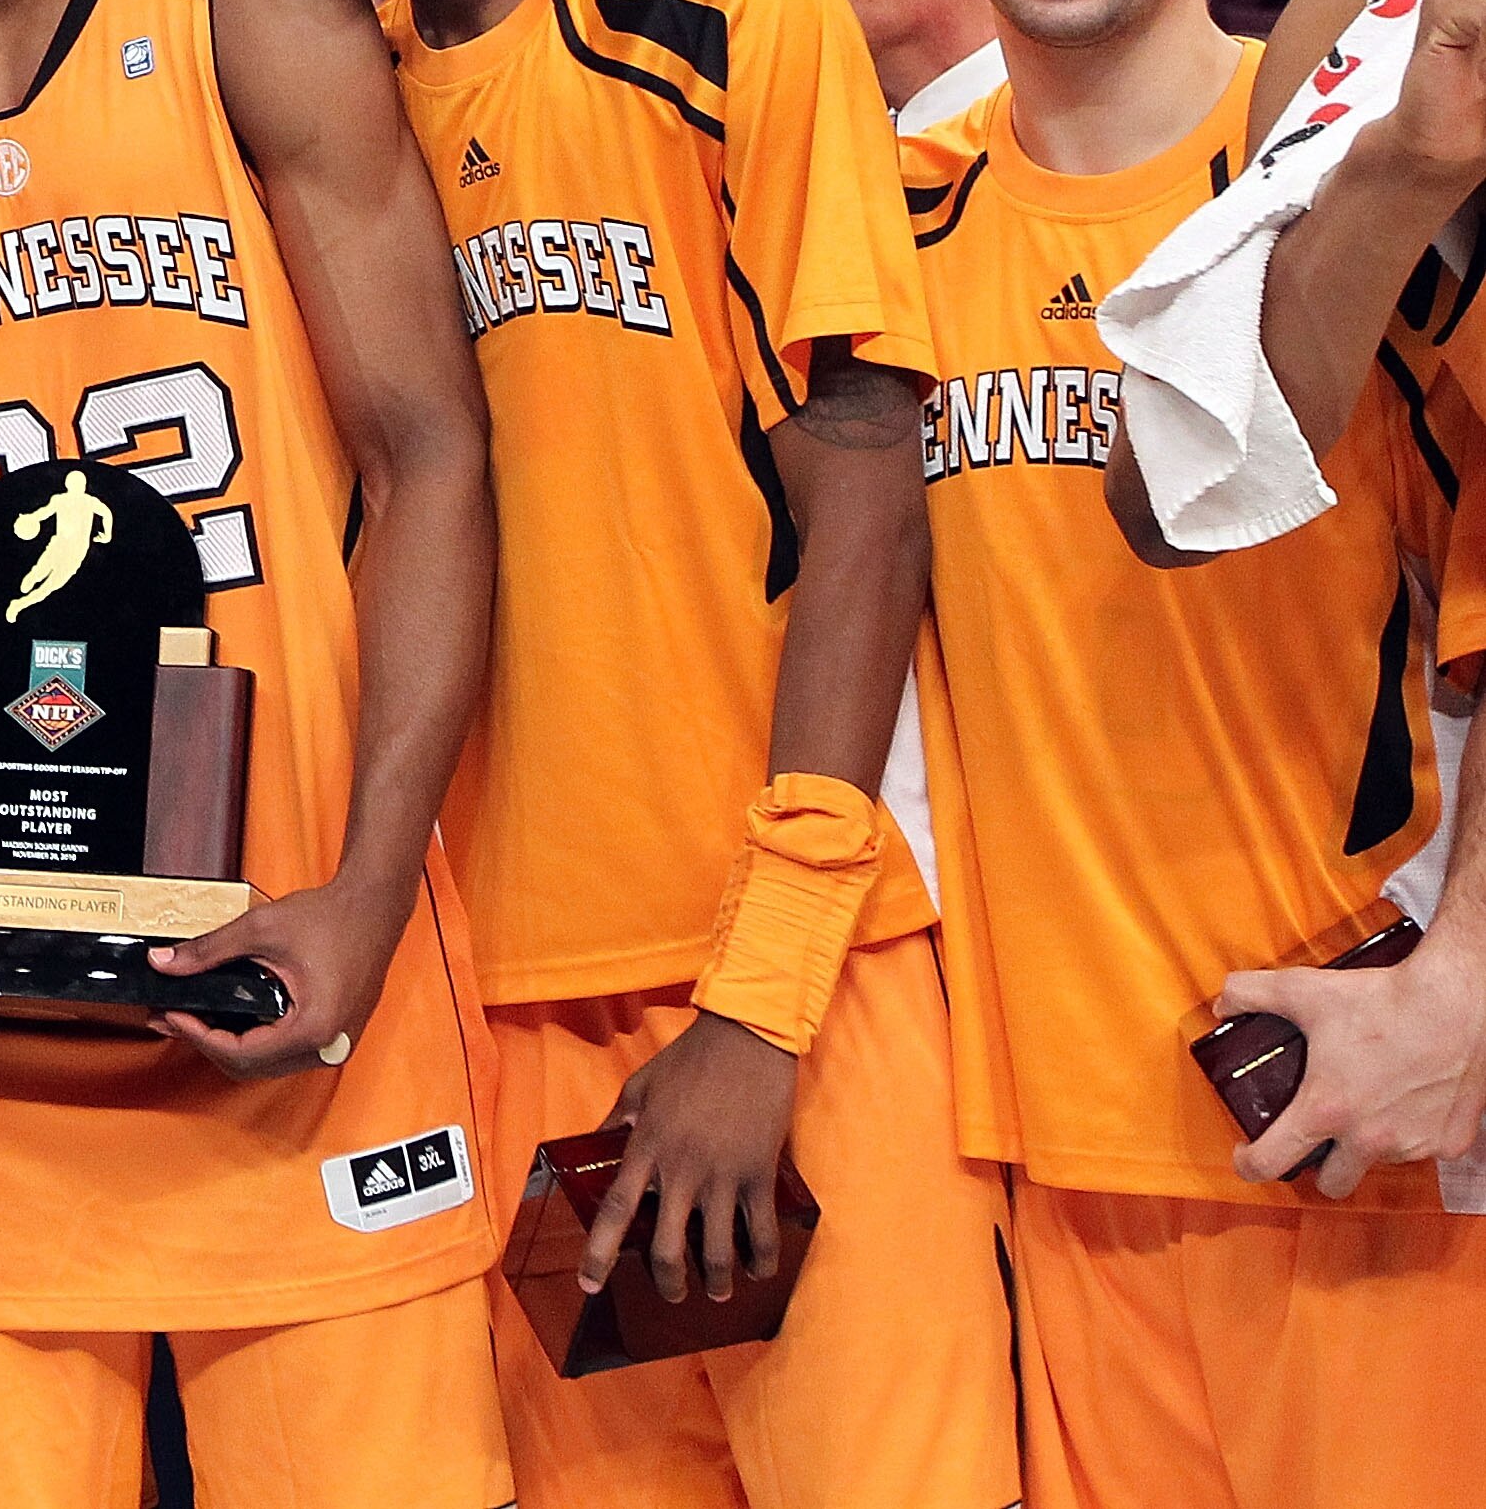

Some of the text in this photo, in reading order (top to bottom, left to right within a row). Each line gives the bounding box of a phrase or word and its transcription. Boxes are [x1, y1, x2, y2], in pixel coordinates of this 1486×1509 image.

[459, 161, 501, 189] adidas
[34, 646, 82, 665] DICK'S
[30, 703, 81, 721] NIT
[30, 789, 68, 802] MOST
[0, 803, 96, 820] OUTSTANDING
[21, 821, 72, 835] PLAYER
[70, 899, 117, 914] PLAYER
[417, 1151, 445, 1172] 3XL
[363, 1176, 406, 1197] adidas
